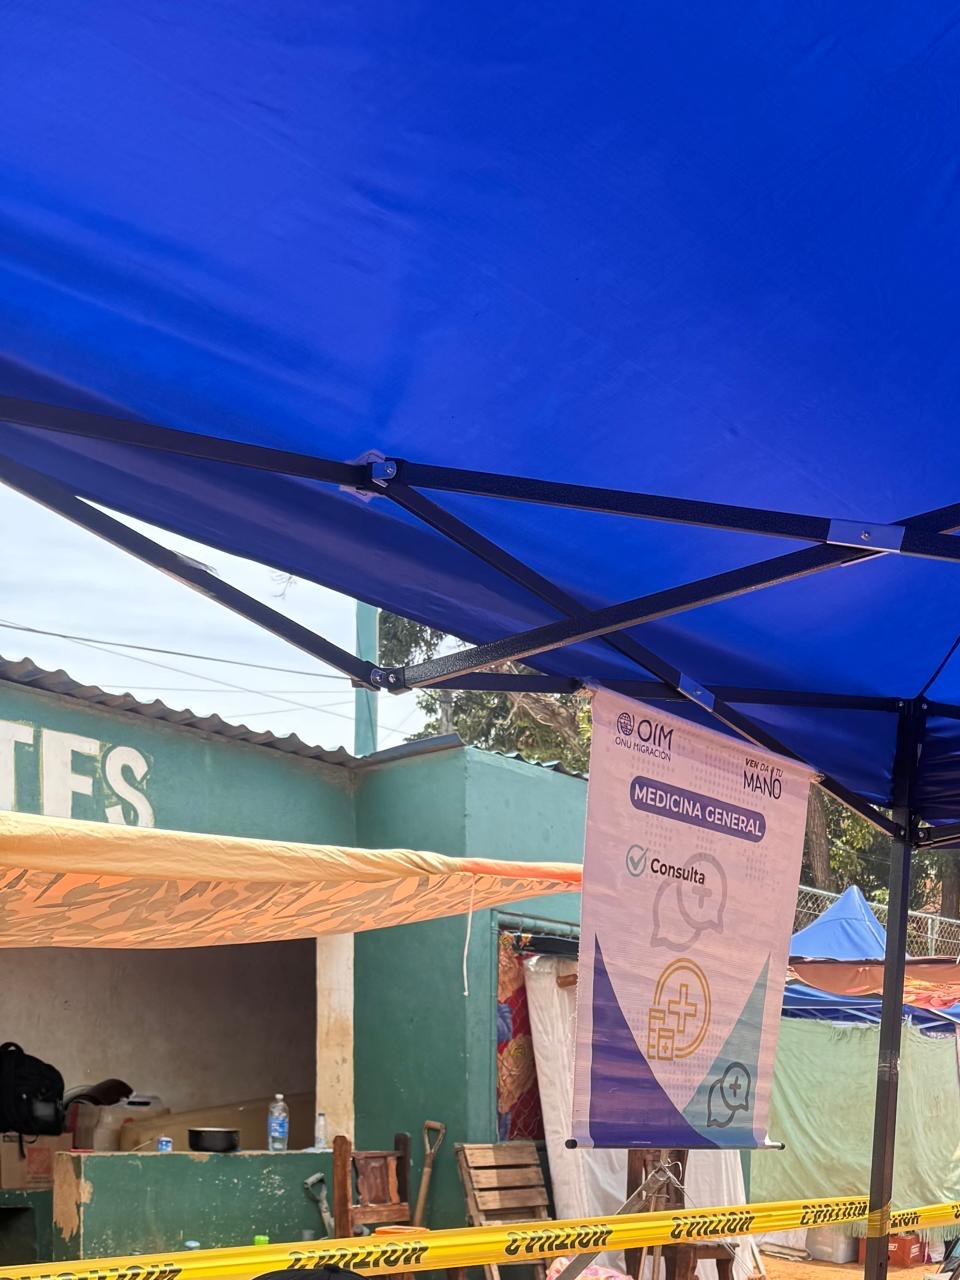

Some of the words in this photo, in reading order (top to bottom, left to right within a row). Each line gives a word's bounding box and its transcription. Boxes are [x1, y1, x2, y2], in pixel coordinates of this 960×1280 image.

[615, 736, 632, 749] ONU
[637, 719, 674, 751] OIM
[745, 758, 758, 769] VEN
[759, 762, 769, 773] DA
[743, 767, 782, 800] MANO
[634, 783, 702, 820] MEDICINA
[705, 805, 763, 837] GENERAL
[650, 858, 706, 885] Consulta
